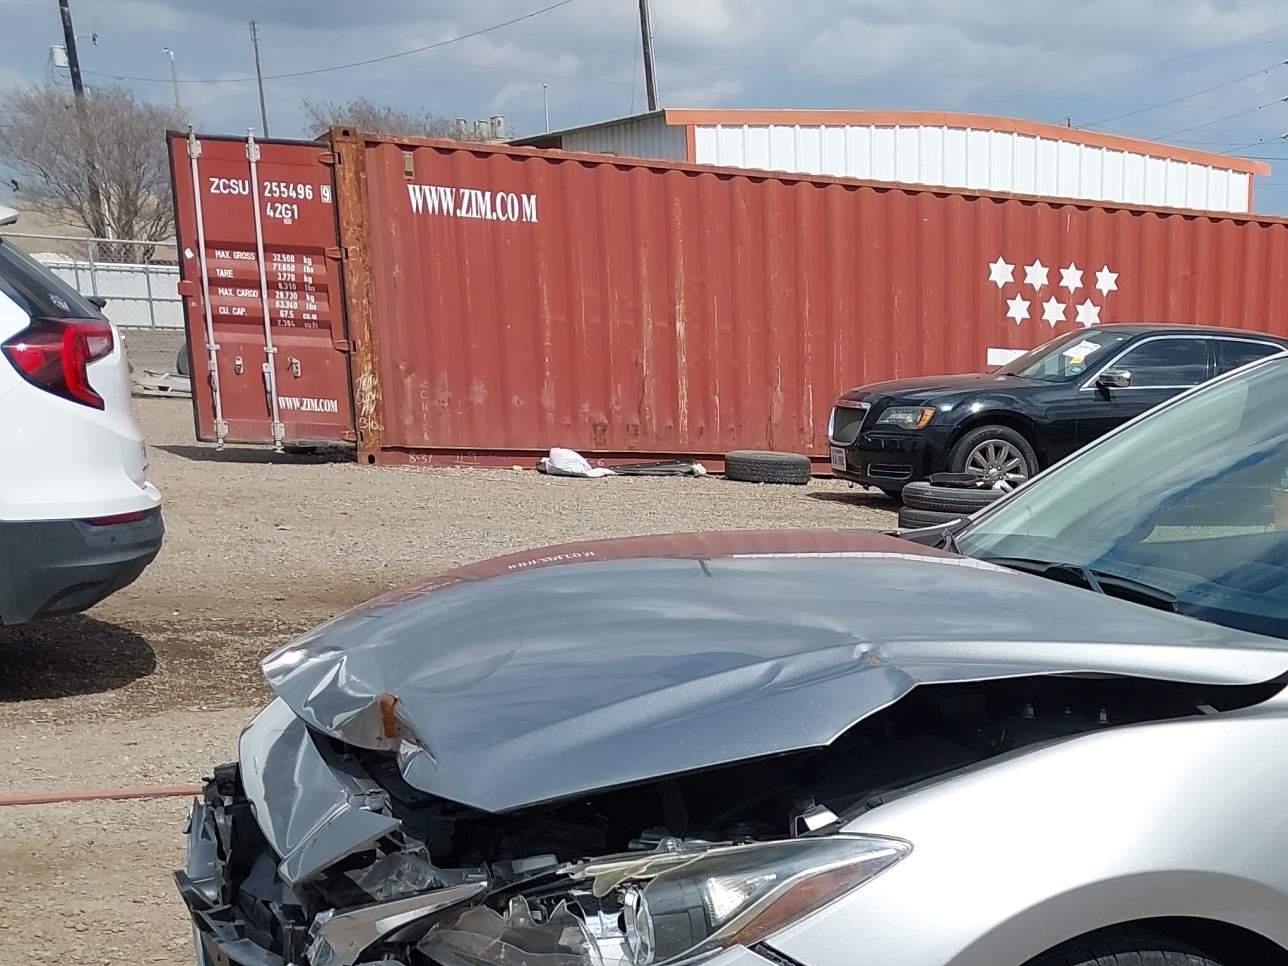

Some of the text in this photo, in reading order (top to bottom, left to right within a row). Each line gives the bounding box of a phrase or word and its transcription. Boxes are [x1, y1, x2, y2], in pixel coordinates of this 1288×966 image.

[209, 177, 332, 203] ZCSU 255496 9
[266, 202, 298, 219] 42G1
[406, 183, 538, 223] WWW.ZIM.COM
[233, 251, 256, 261] GROSS
[303, 255, 312, 265] kg
[216, 268, 234, 278] TARE
[303, 274, 313, 285] kg
[303, 264, 314, 273] lbs
[236, 289, 258, 298] CARGO
[306, 293, 315, 304] kg
[232, 307, 248, 316] CAP.
[306, 302, 317, 311] lbs
[278, 395, 338, 413] WWW.ZIM.COM
